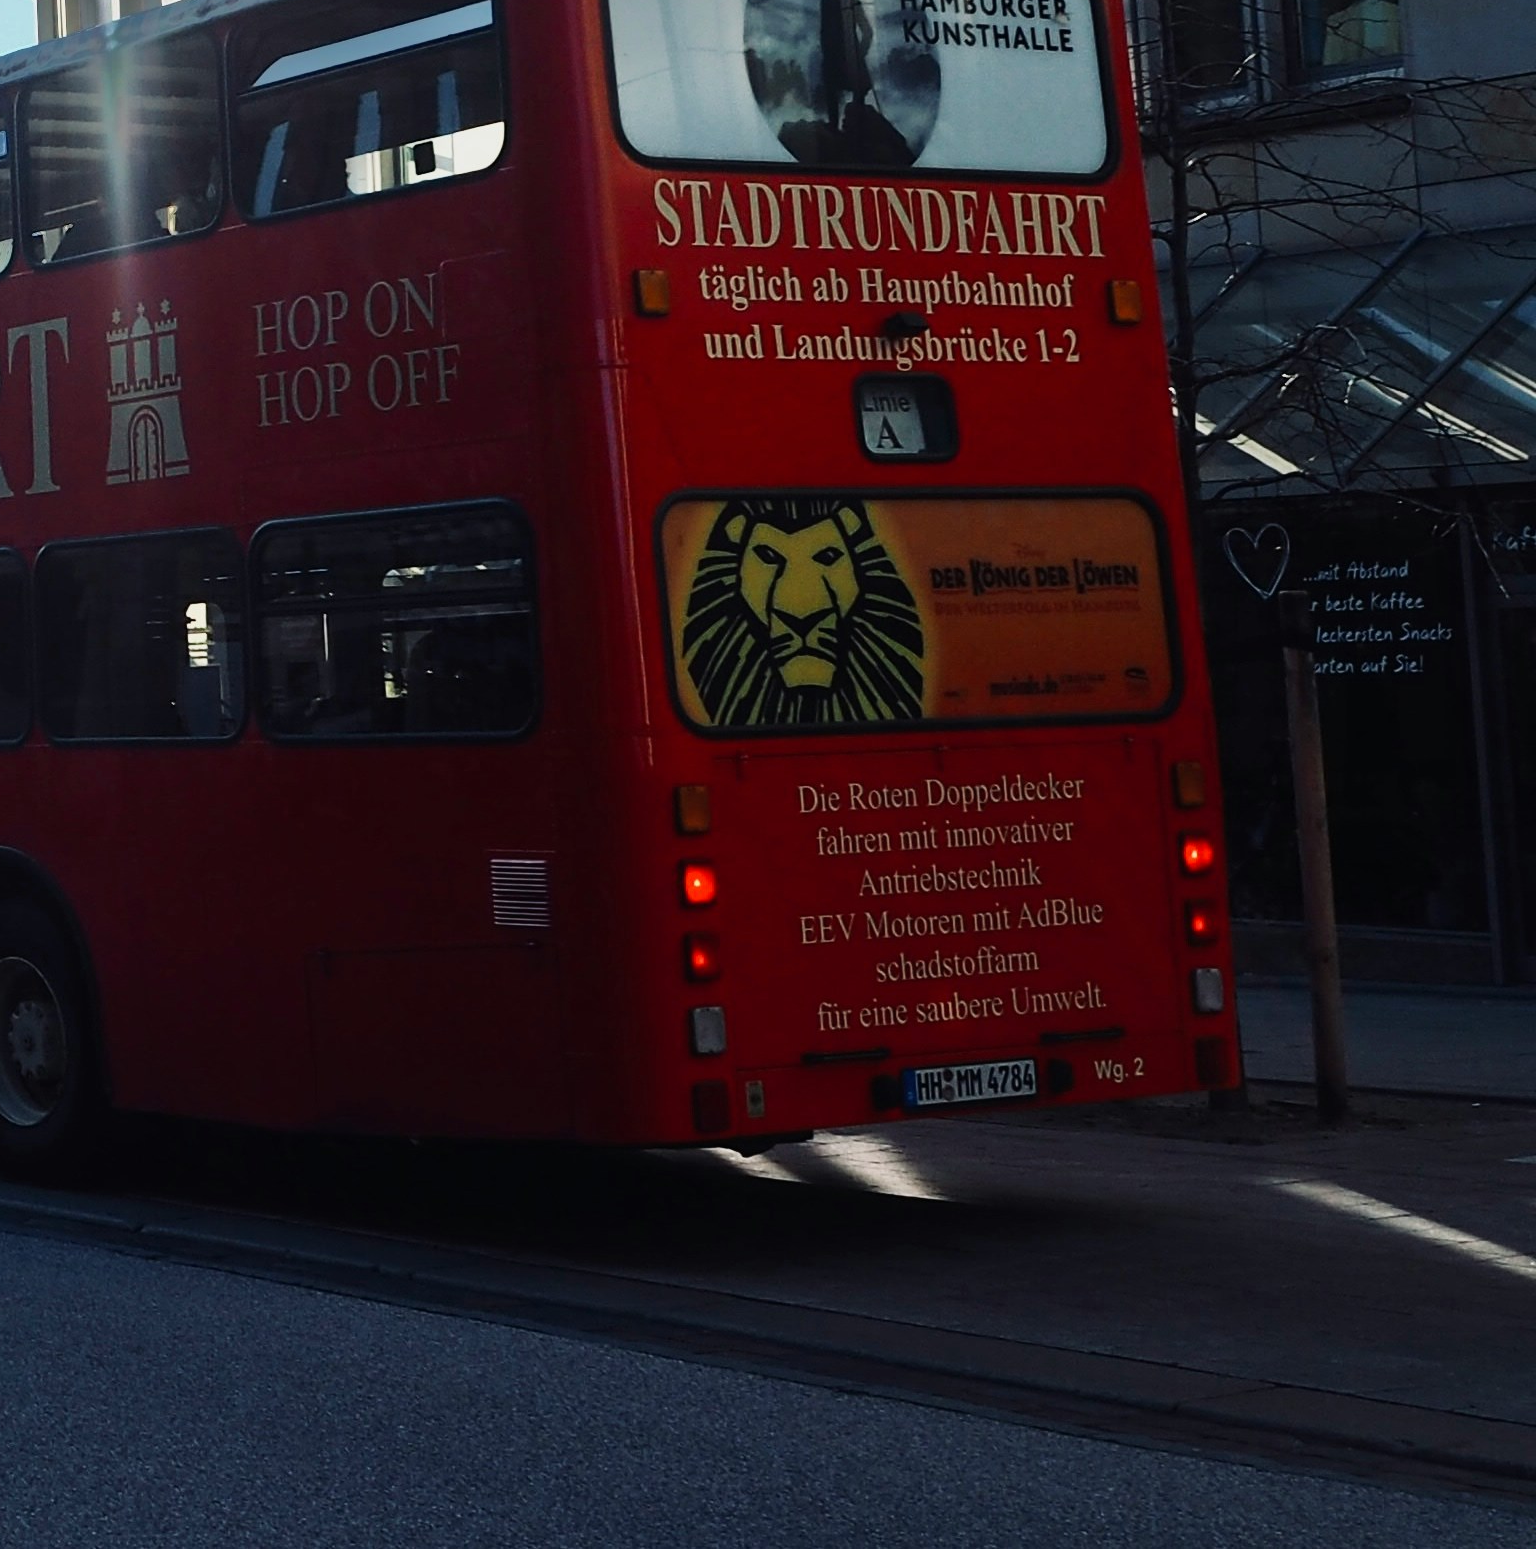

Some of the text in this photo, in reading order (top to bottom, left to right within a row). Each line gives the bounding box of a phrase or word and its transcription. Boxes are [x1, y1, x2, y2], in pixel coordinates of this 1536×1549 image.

[903, 19, 1074, 52] KUNSTHALLE
[653, 178, 1106, 257] STADTRUNDFAHRT
[699, 265, 1074, 314] täglich ab Hauptbahnhof
[252, 272, 437, 356] HOP ON
[704, 324, 1081, 371] und Landungsbrücke 1-2
[256, 344, 461, 427] HOP OFF
[876, 415, 905, 449] A
[931, 558, 1139, 595] DER KÖNIG DER LÖWEN
[1347, 560, 1409, 580] Abstand
[1325, 593, 1365, 611] beste
[1370, 592, 1426, 611] Kaffee
[1316, 622, 1454, 644] leckersten Snacks
[1313, 654, 1424, 674] arten auf Sie!
[798, 772, 1085, 813] Die Roten Doppeldecker
[817, 816, 1075, 856] fahren mit innovativer
[859, 858, 1043, 897] Antriebstechnik
[800, 898, 1104, 944] EEV Motoren mit AdBlue
[876, 946, 1040, 983] schadstoffarm
[818, 981, 1107, 1031] für eine saubere Umwelt.
[916, 1070, 943, 1101] HH
[957, 1068, 984, 1098] MM
[988, 1064, 1034, 1094] 4784
[1094, 1057, 1145, 1083] Wg. 2
